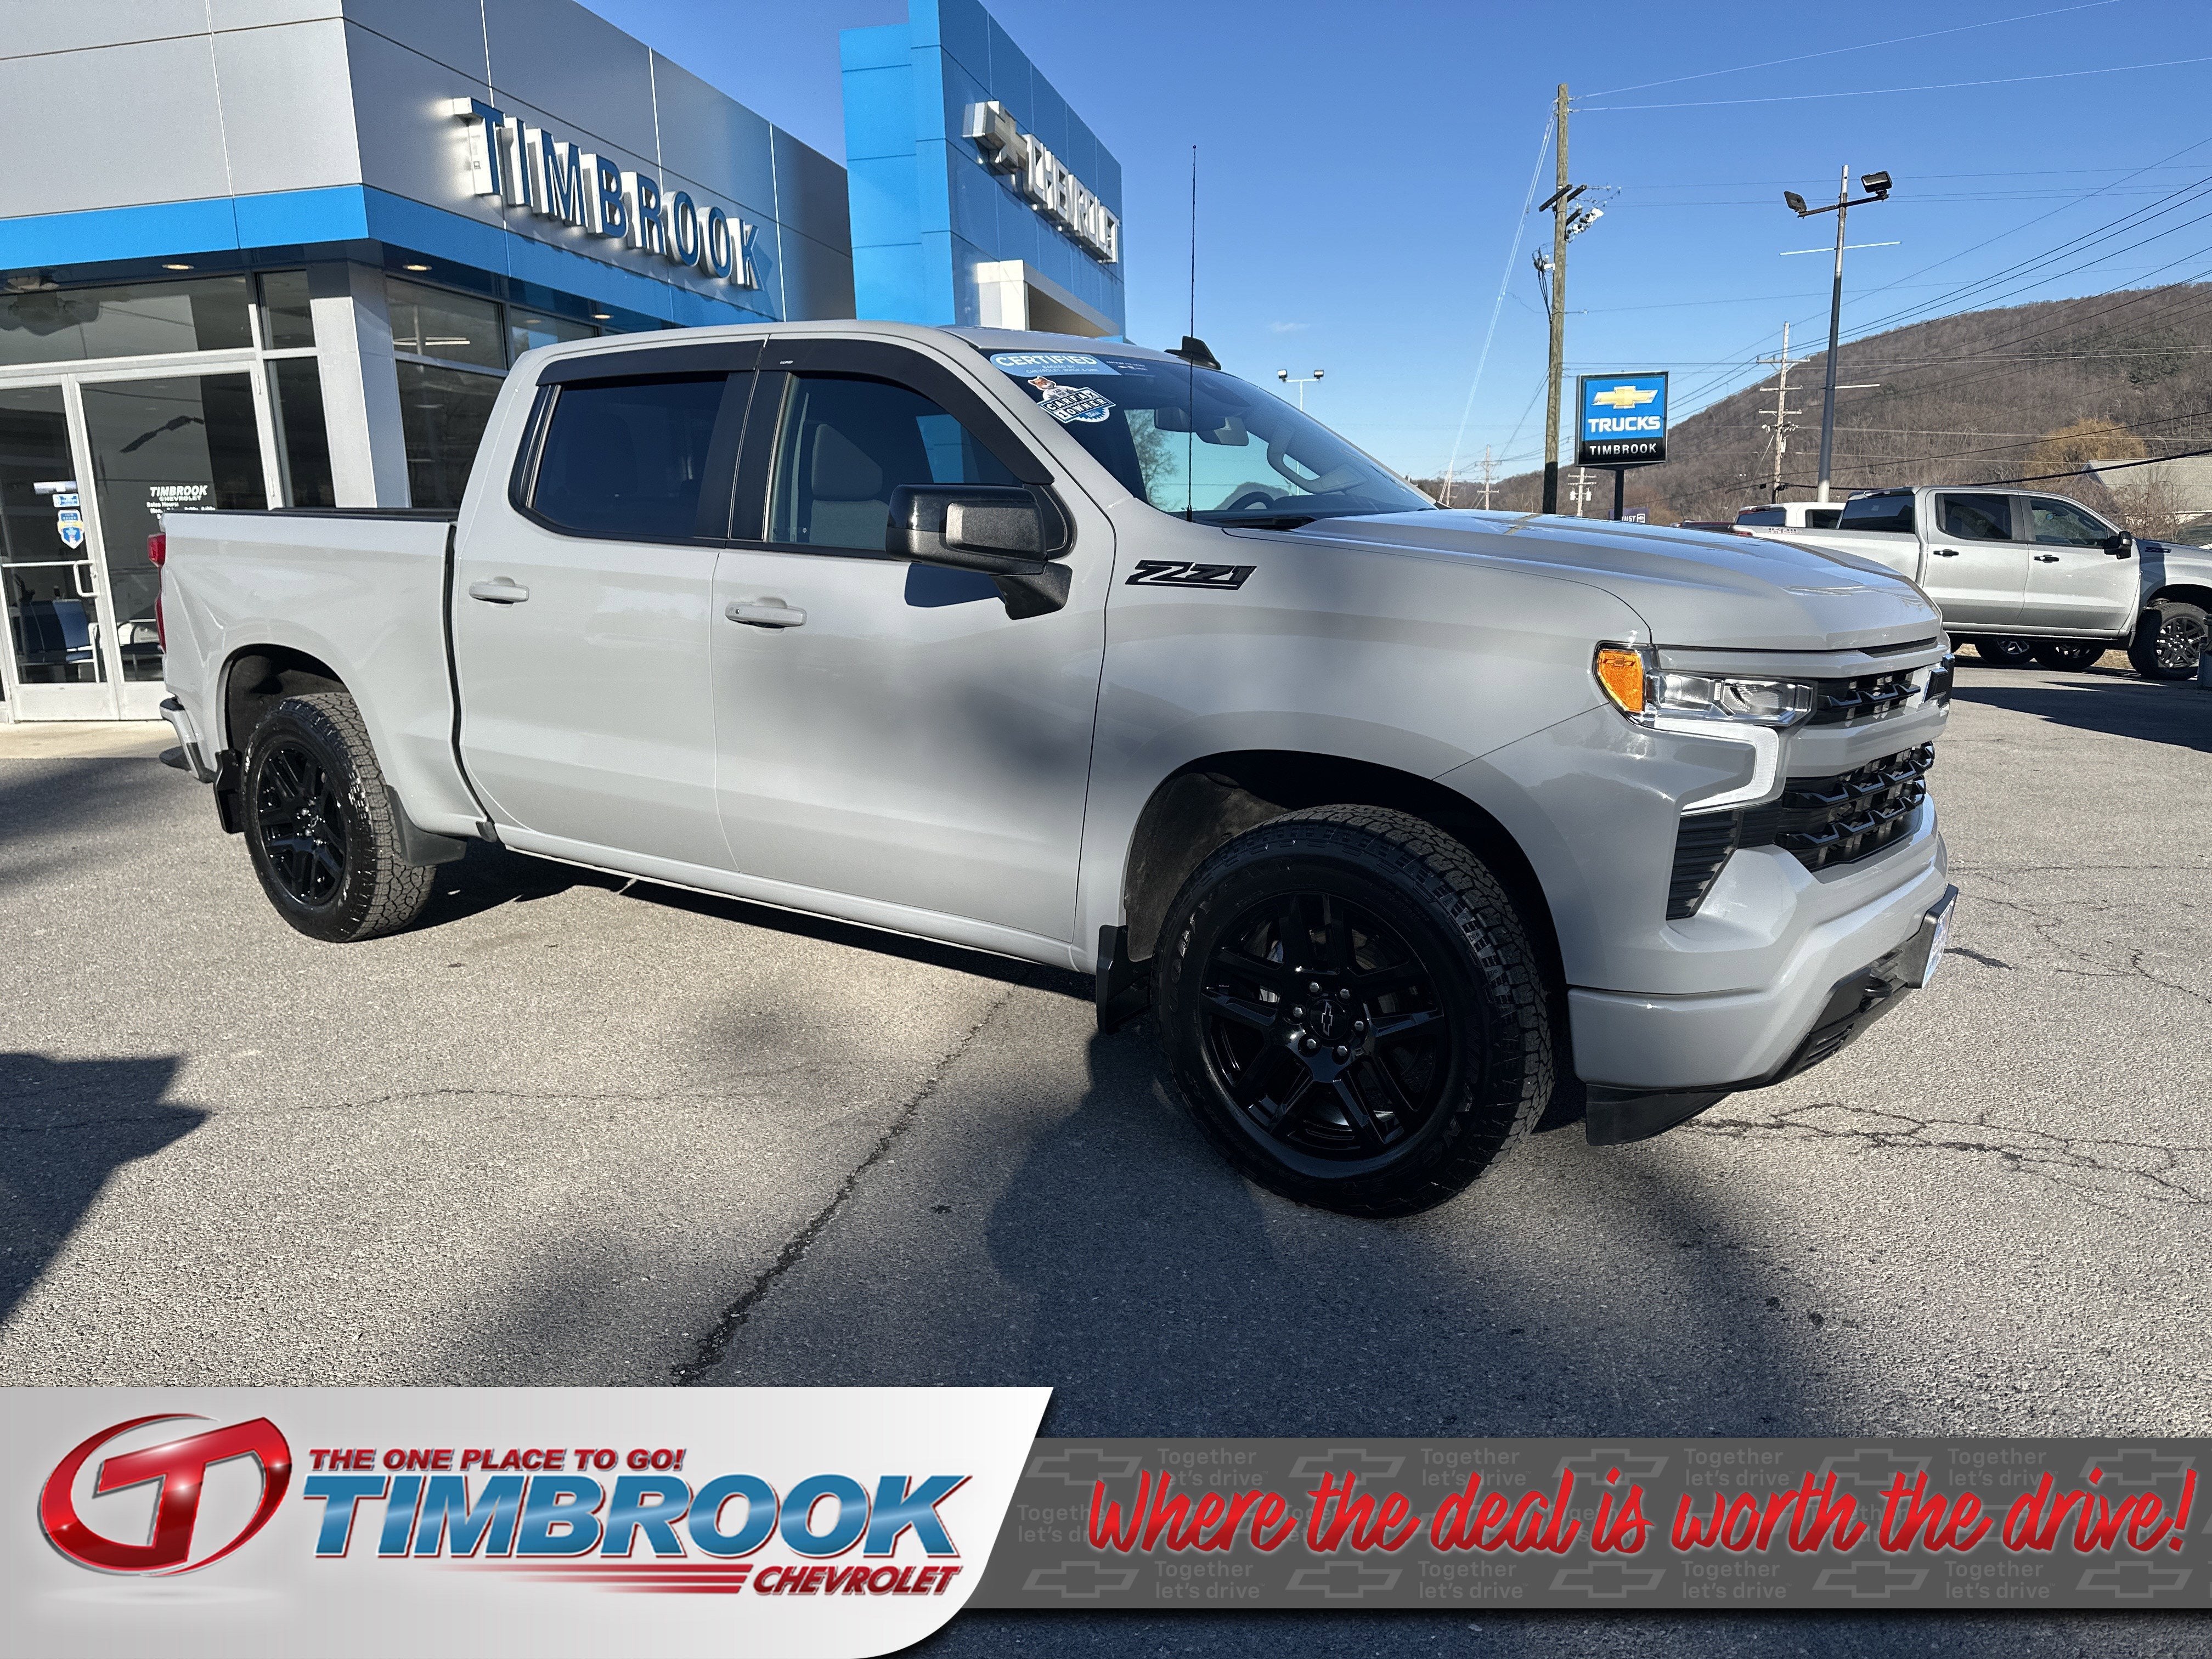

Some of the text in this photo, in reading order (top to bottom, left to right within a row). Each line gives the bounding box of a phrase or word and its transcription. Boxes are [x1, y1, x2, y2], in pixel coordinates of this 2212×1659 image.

[453, 97, 764, 291] TIMBROOK
[995, 355, 1097, 366] CERTIFIED
[1046, 392, 1097, 411] CARFAX
[1066, 398, 1107, 415] OWNER
[1588, 416, 1661, 433] TRUCKS
[1589, 443, 1657, 455] TIMBROOK
[150, 485, 208, 497] TIMBROOK
